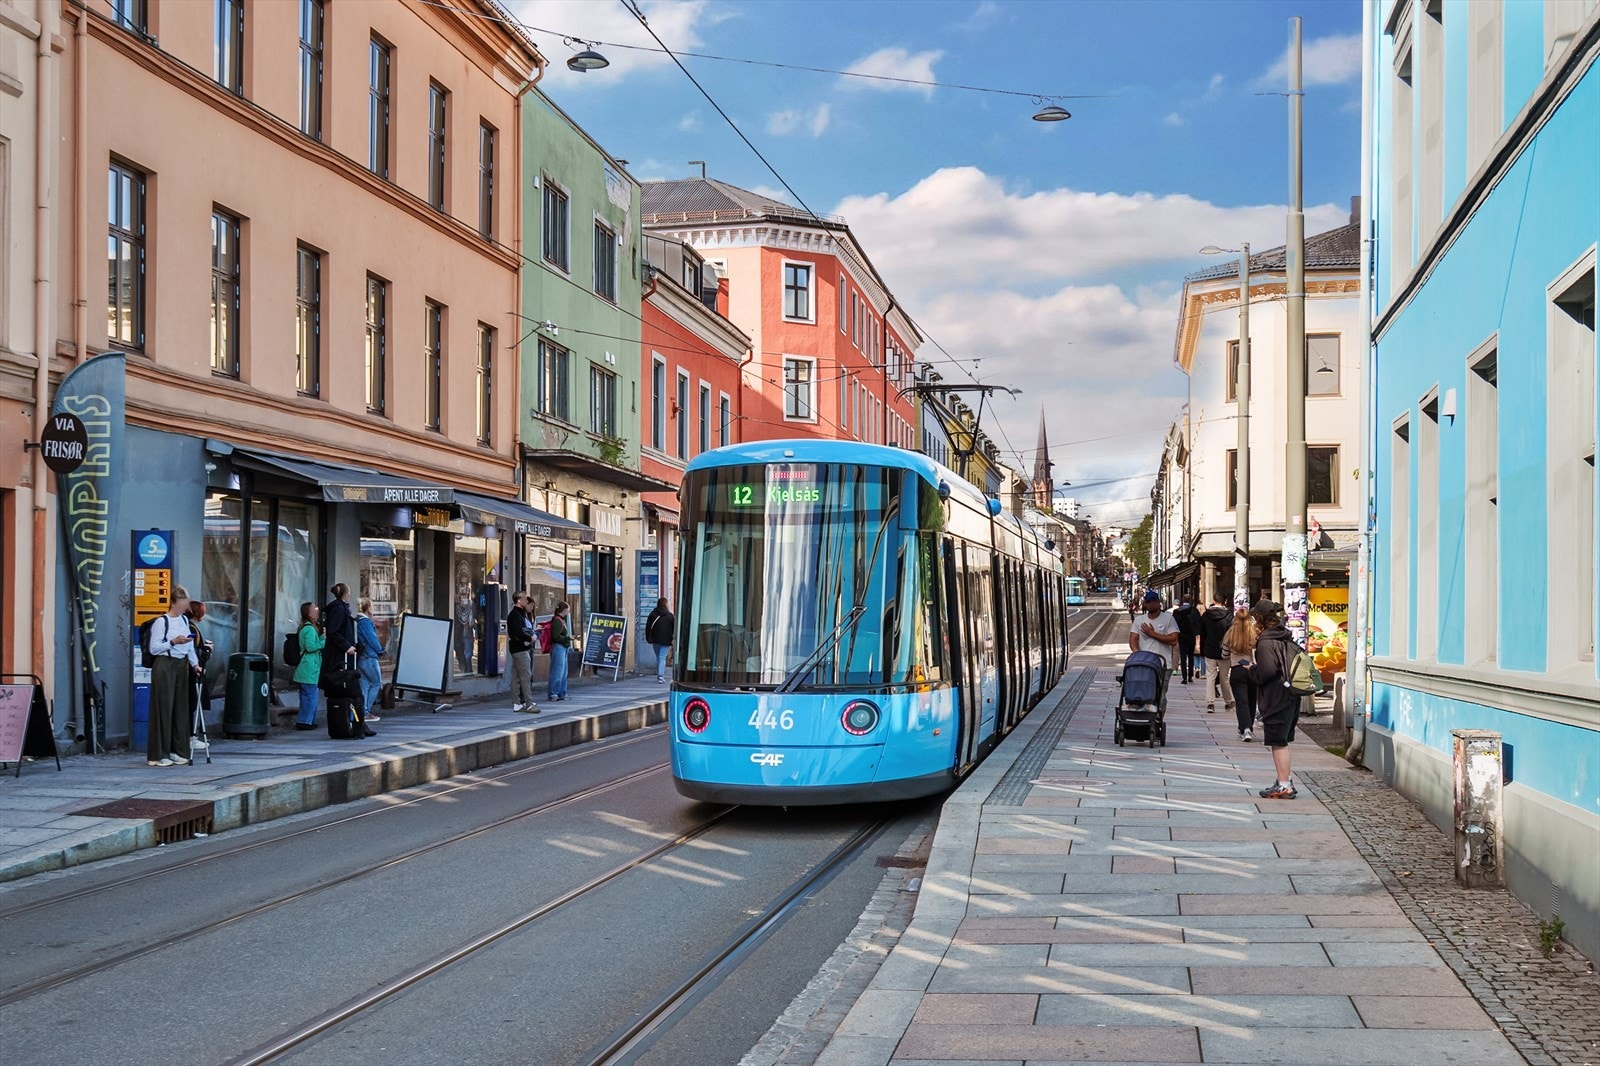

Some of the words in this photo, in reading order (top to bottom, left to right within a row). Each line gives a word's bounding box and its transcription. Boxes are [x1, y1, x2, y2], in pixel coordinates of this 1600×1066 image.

[55, 417, 75, 431] VIA
[45, 440, 83, 460] FRISØR
[384, 488, 403, 501] ÅPENT
[405, 490, 419, 502] ALLE
[419, 490, 440, 502] DAGER
[733, 486, 752, 504] 12
[767, 486, 820, 505] Kjelsås
[595, 509, 621, 537] SMASH
[148, 540, 159, 554] 5
[592, 616, 624, 629] ÅPENT!
[748, 709, 794, 730] 446
[750, 752, 785, 767] CAF
